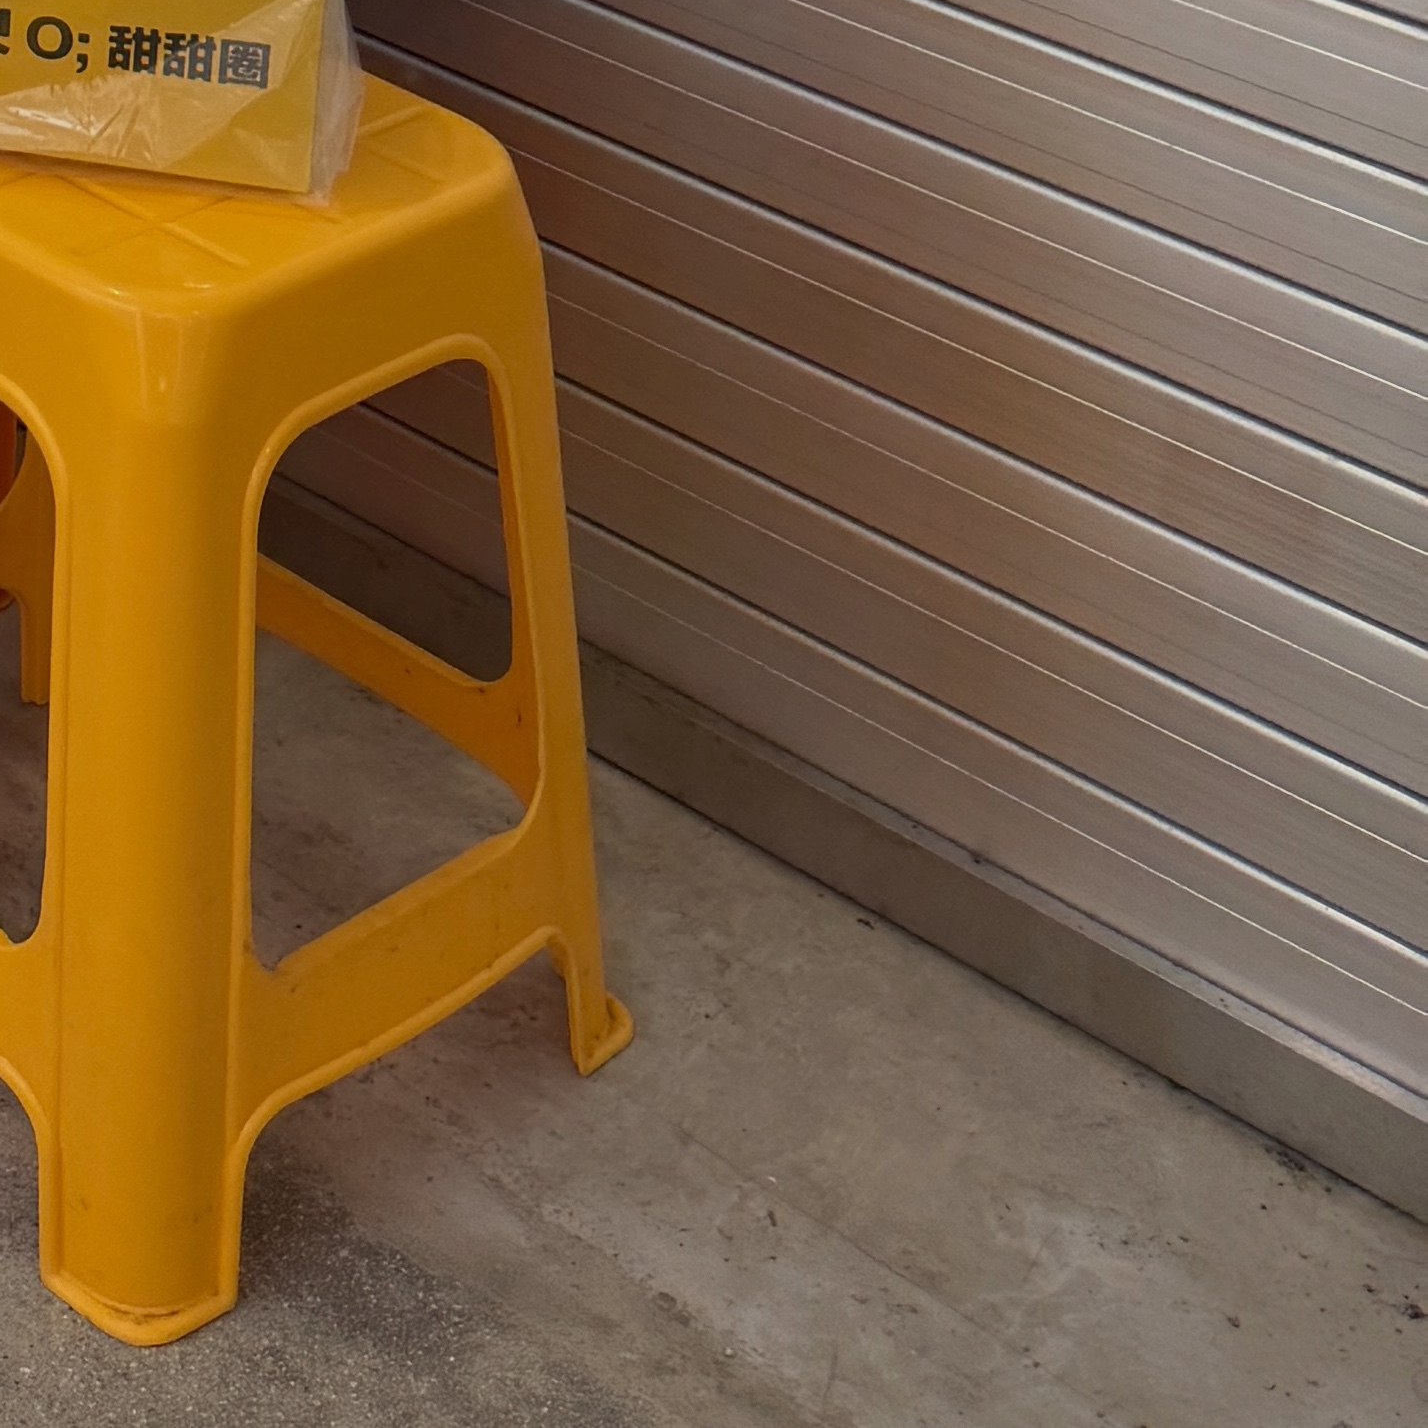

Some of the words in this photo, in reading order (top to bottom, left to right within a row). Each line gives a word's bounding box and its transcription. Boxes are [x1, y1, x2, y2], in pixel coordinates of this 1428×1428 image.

[26, 15, 90, 74] O;
[107, 23, 271, 90] 甜甜圈
